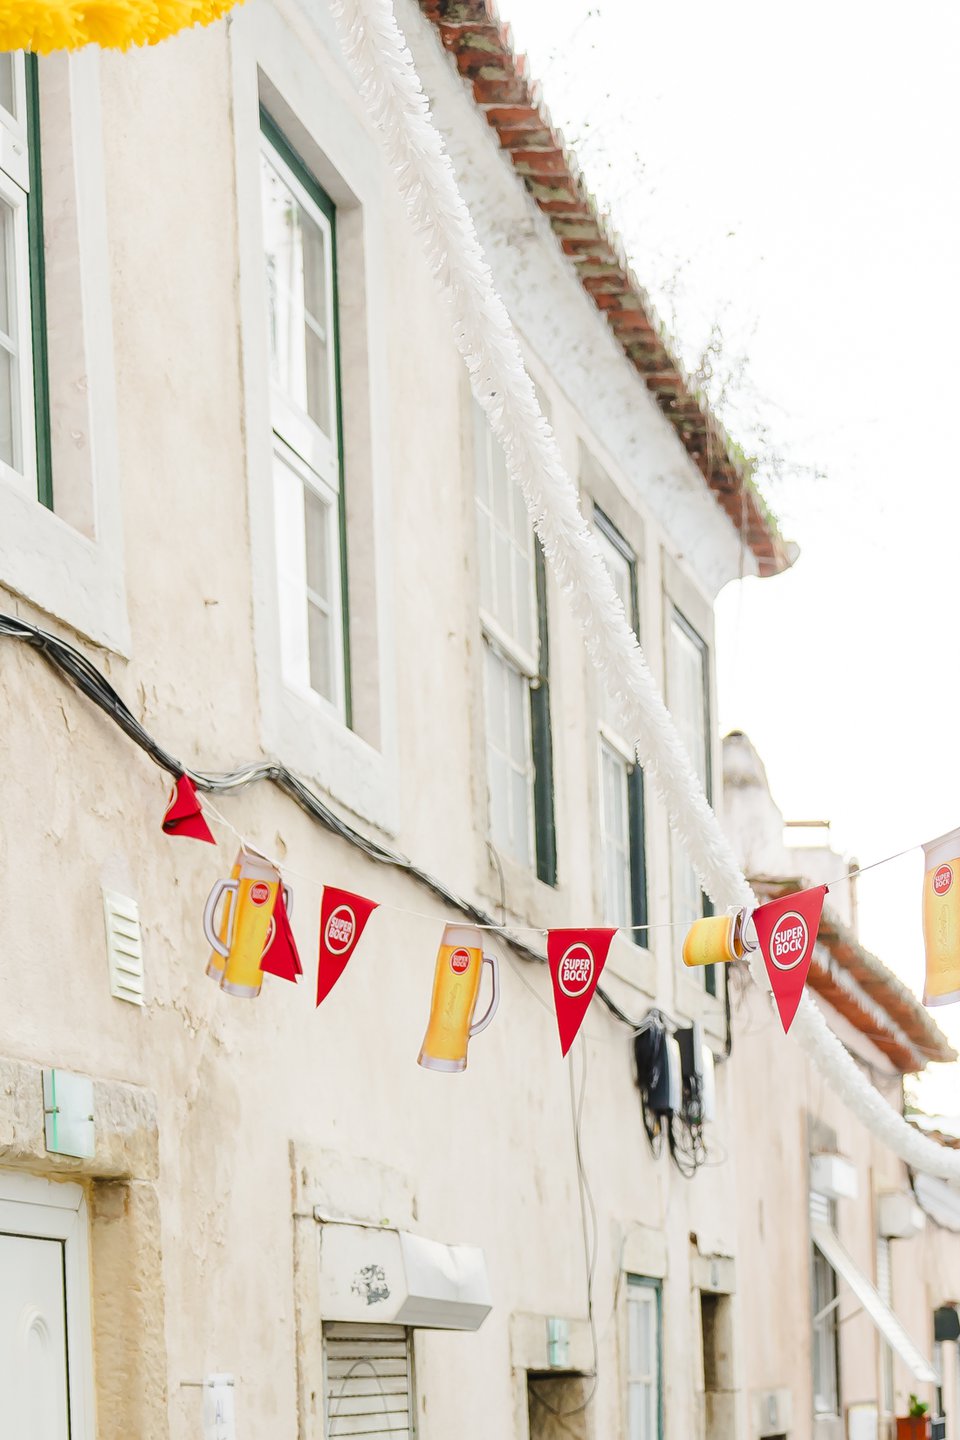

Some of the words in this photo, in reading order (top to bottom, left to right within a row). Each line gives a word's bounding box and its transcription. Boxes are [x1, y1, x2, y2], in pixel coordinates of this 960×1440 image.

[331, 916, 353, 931] SUPER
[329, 928, 349, 943] BOCK
[774, 926, 803, 944] SUPER
[776, 937, 803, 956] BOCK
[563, 958, 590, 971] SUPER
[563, 970, 588, 982] BOCK
